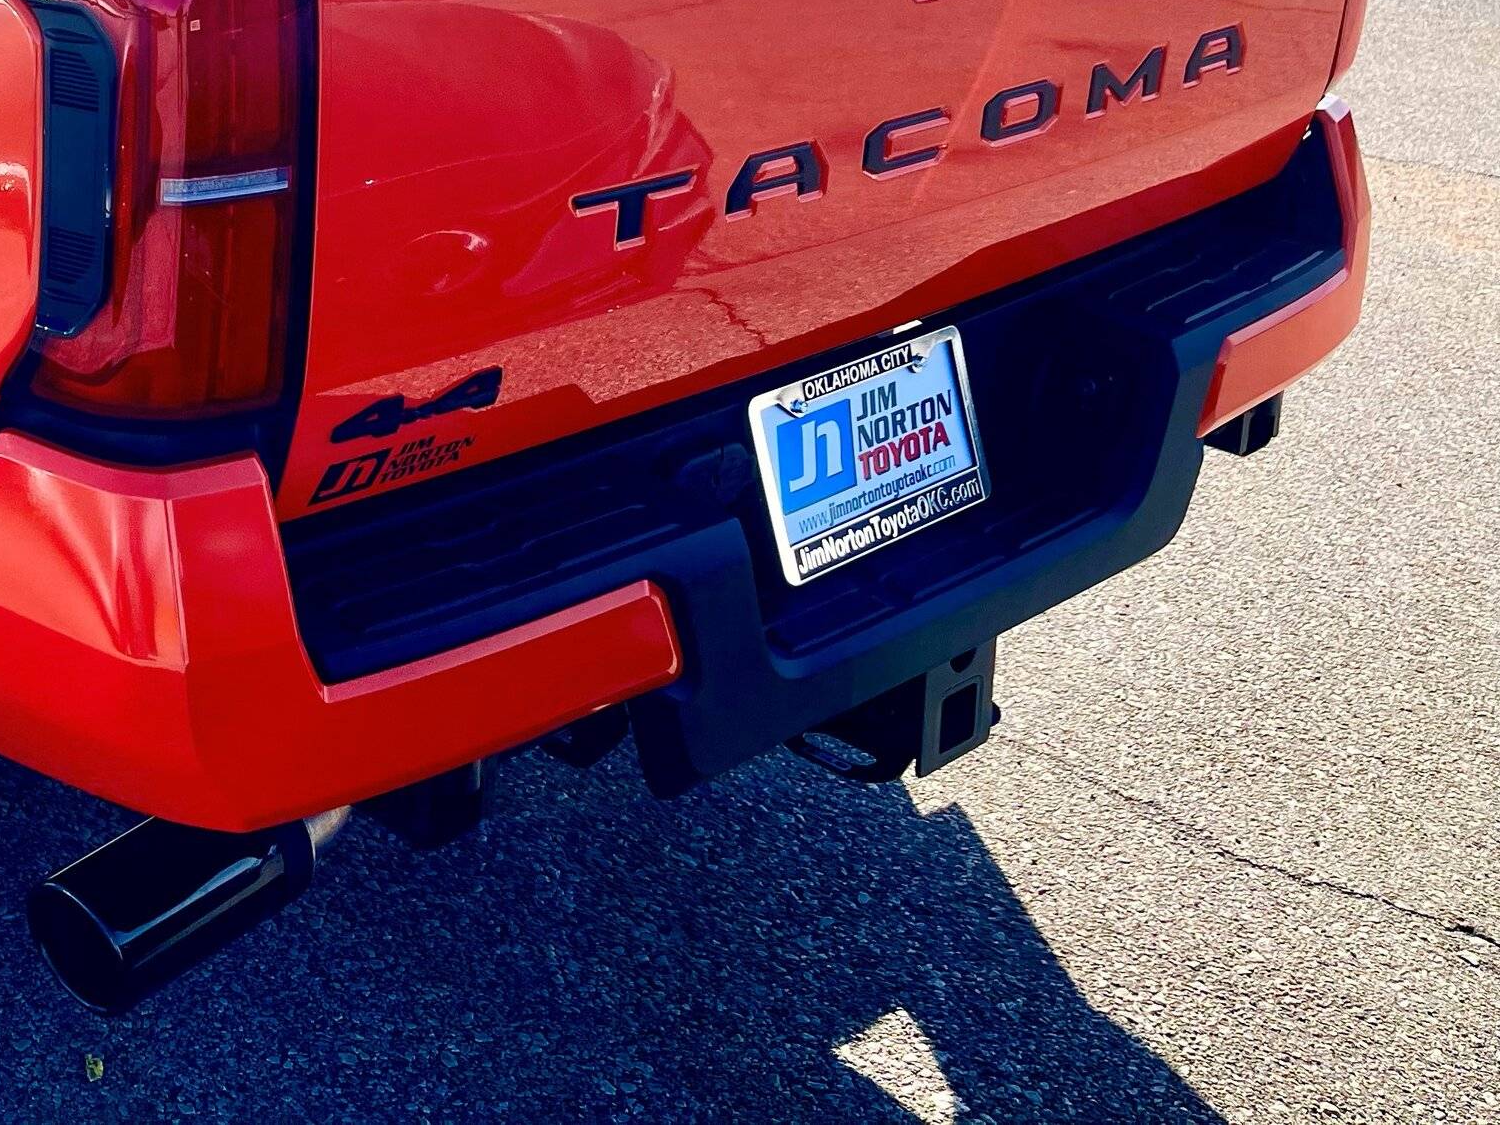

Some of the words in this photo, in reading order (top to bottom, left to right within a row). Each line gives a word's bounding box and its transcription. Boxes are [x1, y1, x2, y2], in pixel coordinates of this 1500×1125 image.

[570, 22, 1246, 249] TACOMA
[804, 360, 878, 399] OKLAHOMA
[881, 346, 912, 370] CITY
[856, 381, 898, 421] JIM
[400, 435, 436, 455] JIM
[857, 389, 952, 451] NORTON
[389, 435, 477, 470] NORTON
[858, 421, 951, 481] TOYOTA
[798, 454, 956, 534] www.jimnortontoyotaokc.com
[798, 477, 981, 575] JimNortonToyotaOKC.com
